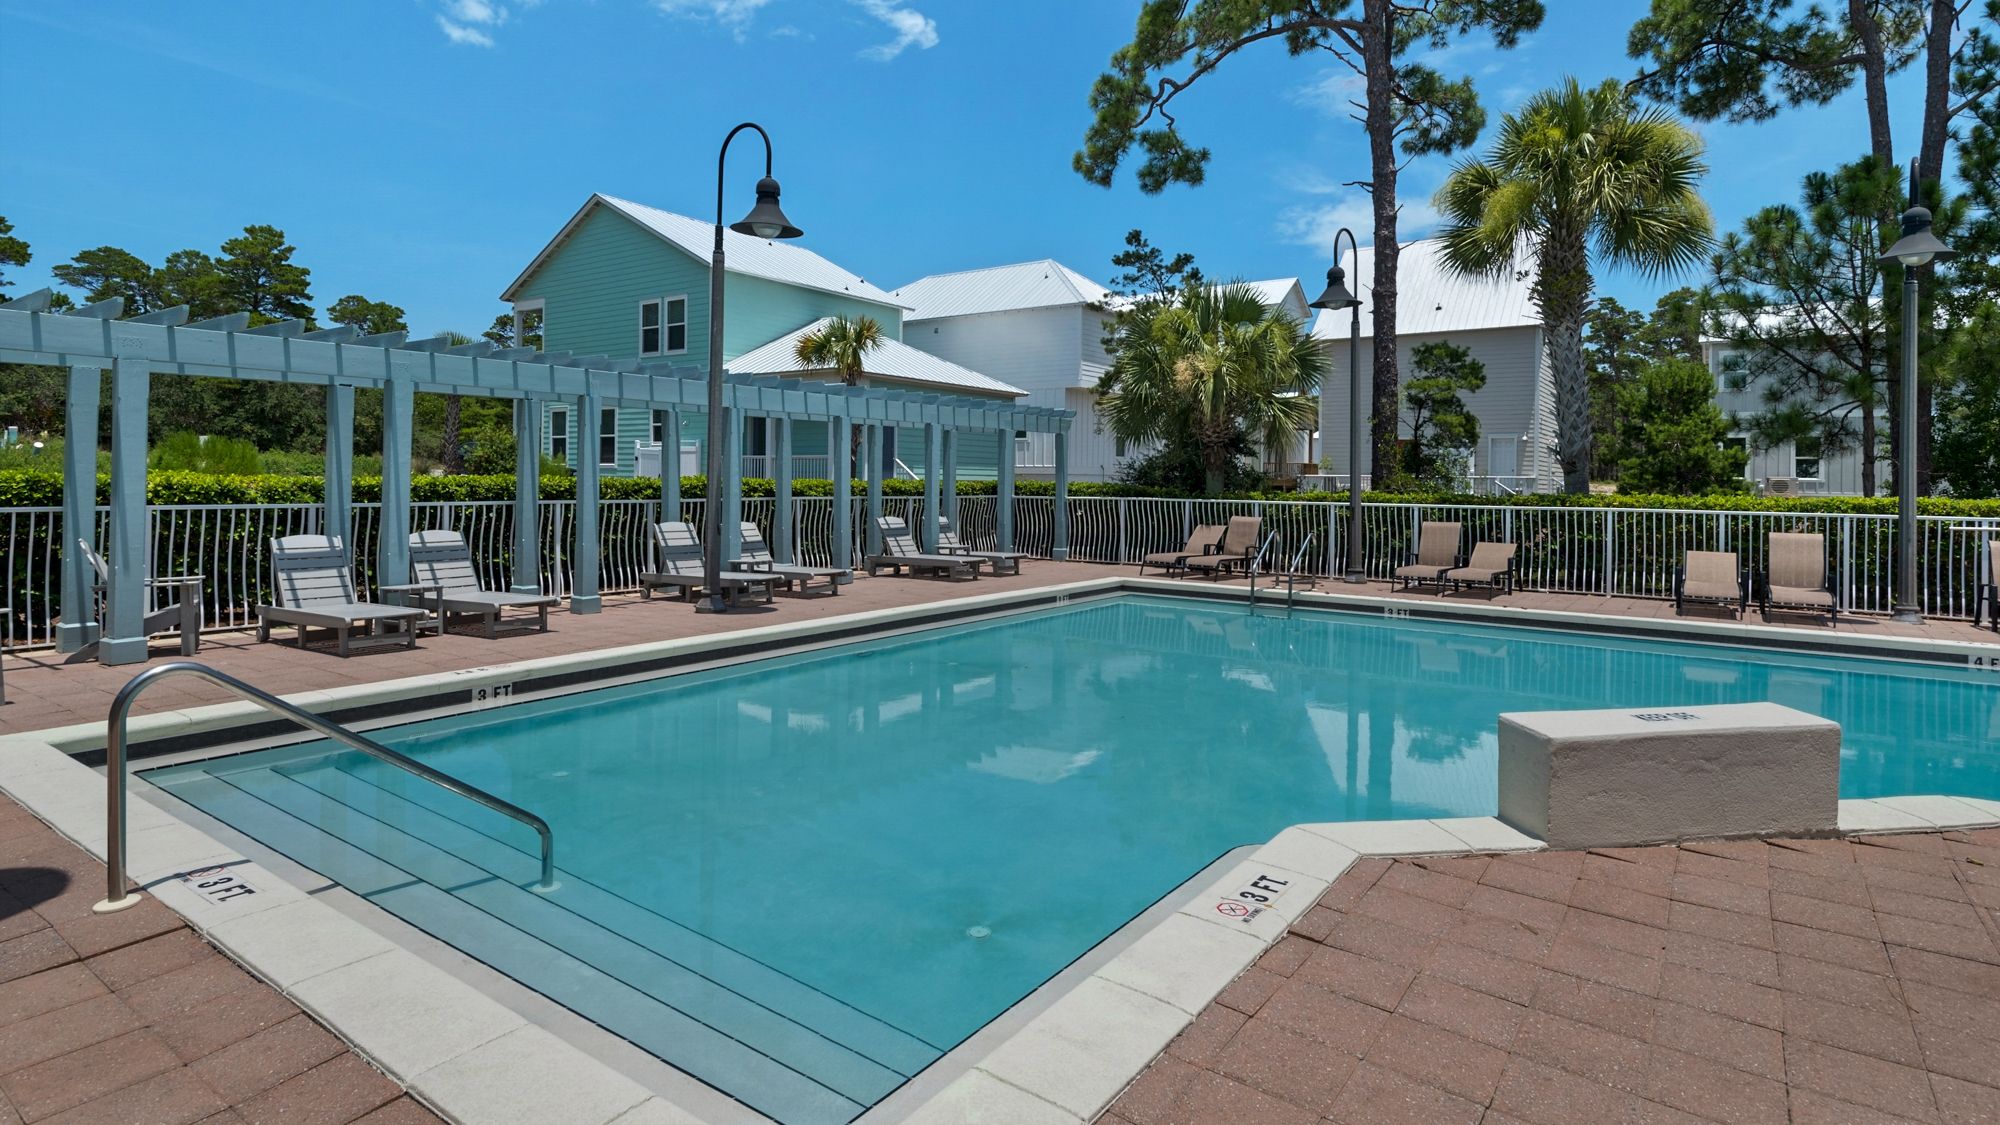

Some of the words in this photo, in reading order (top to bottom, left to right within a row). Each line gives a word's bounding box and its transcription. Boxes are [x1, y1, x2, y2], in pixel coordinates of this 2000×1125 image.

[1387, 608, 1394, 616] 3
[1397, 608, 1409, 617] FT
[1974, 656, 1984, 666] 4
[477, 688, 487, 701] 3
[493, 684, 511, 698] FT
[197, 877, 234, 889] 3
[1250, 875, 1289, 894] FT.
[1239, 891, 1269, 903] 3
